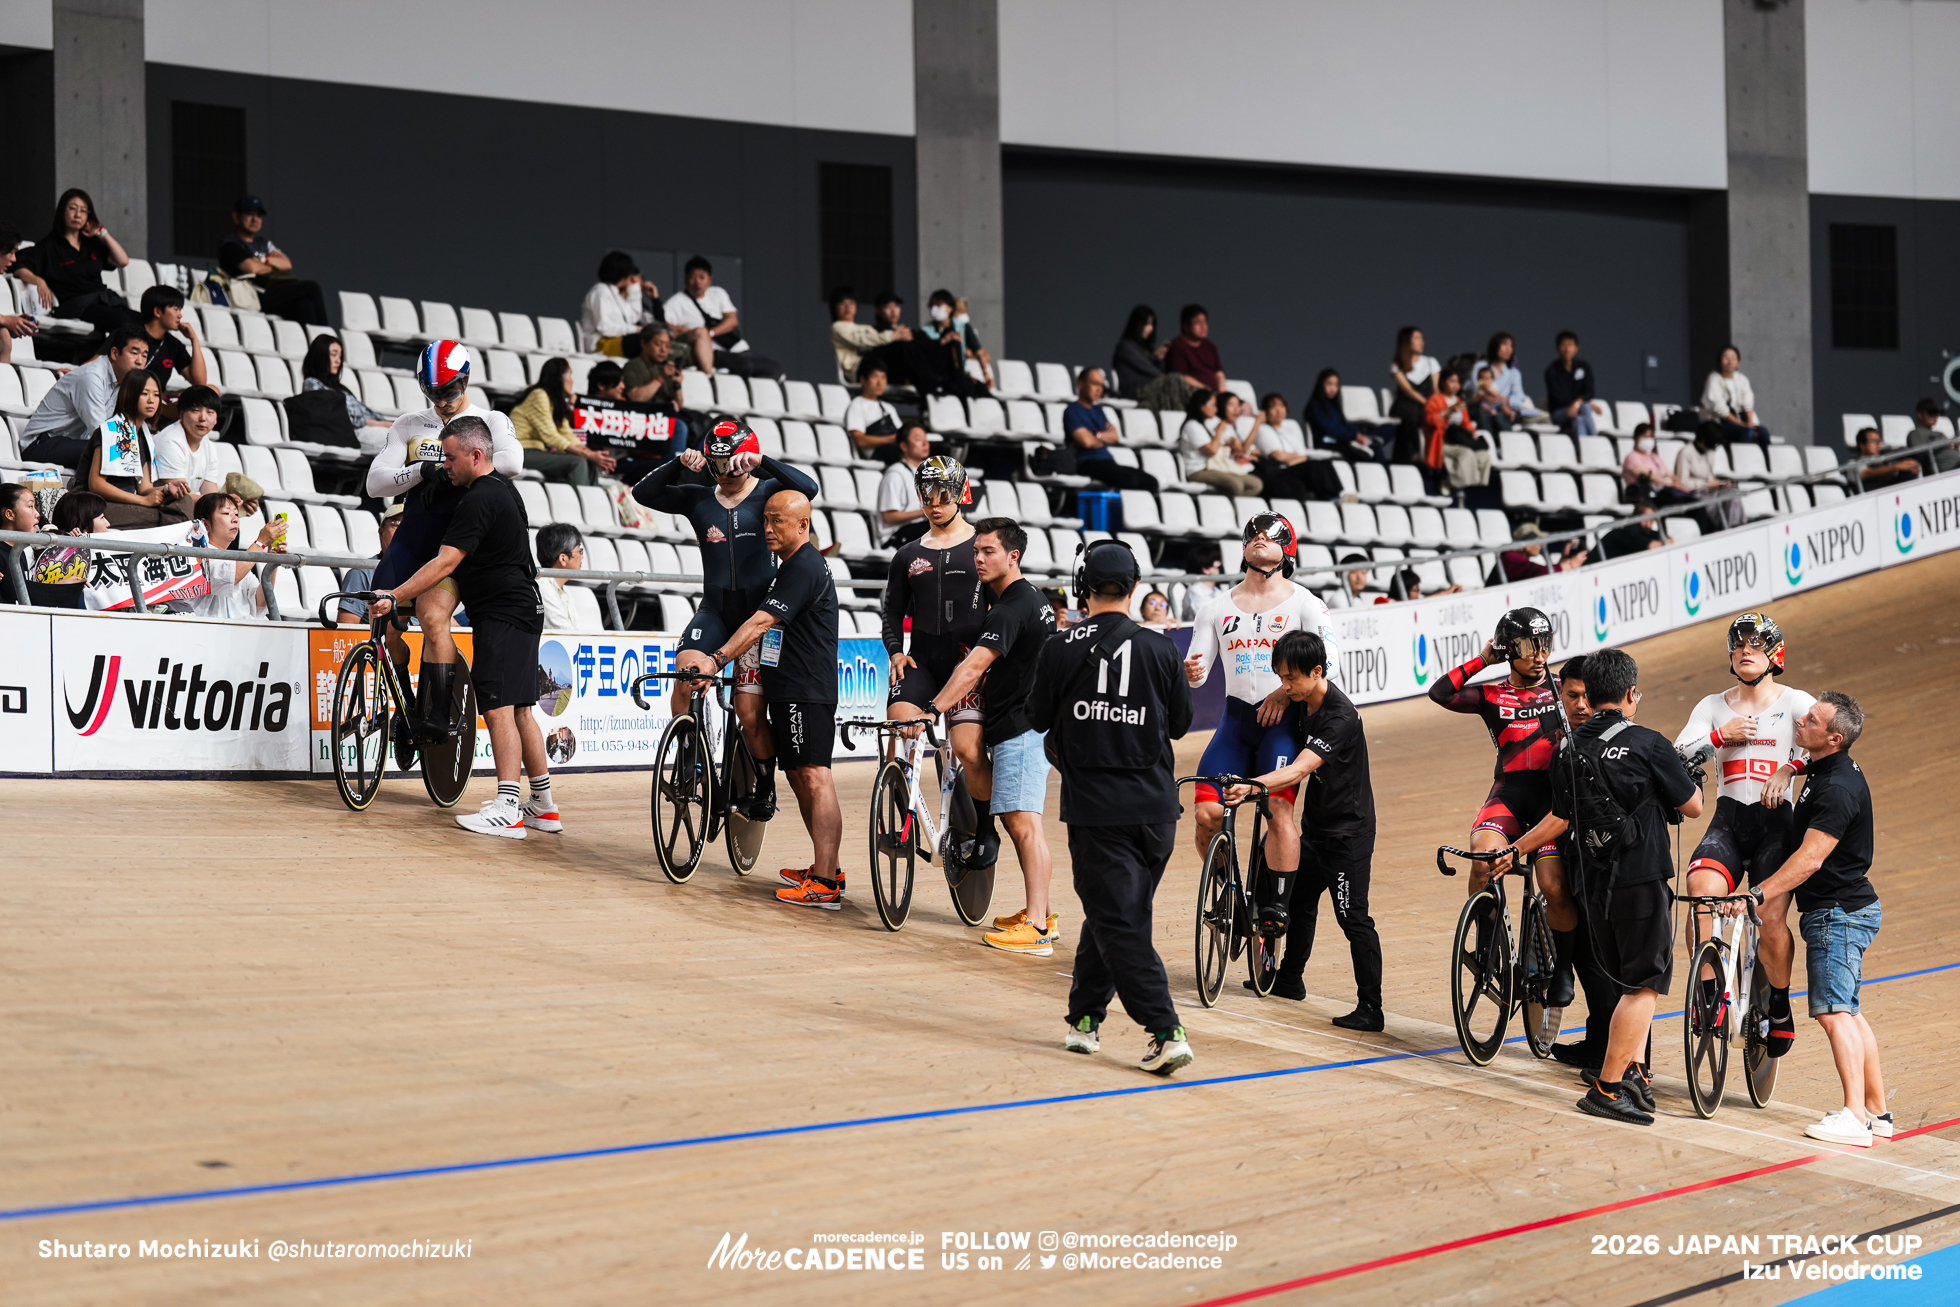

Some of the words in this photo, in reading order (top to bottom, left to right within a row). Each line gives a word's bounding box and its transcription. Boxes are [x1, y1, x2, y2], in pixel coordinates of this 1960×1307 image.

[420, 442, 443, 453] SAL
[1807, 519, 1864, 570] NIPPO
[1704, 551, 1757, 600] NIPPO
[1611, 576, 1659, 626] NIPPO
[1065, 624, 1098, 643] JCF
[124, 657, 293, 732] vittoria
[1073, 700, 1147, 726] Official
[581, 740, 600, 752] TEL
[601, 739, 679, 752] 055-948-004
[789, 703, 800, 754] JAPAN
[1482, 821, 1503, 831] TEAM
[1337, 872, 1347, 918] JAPAN
